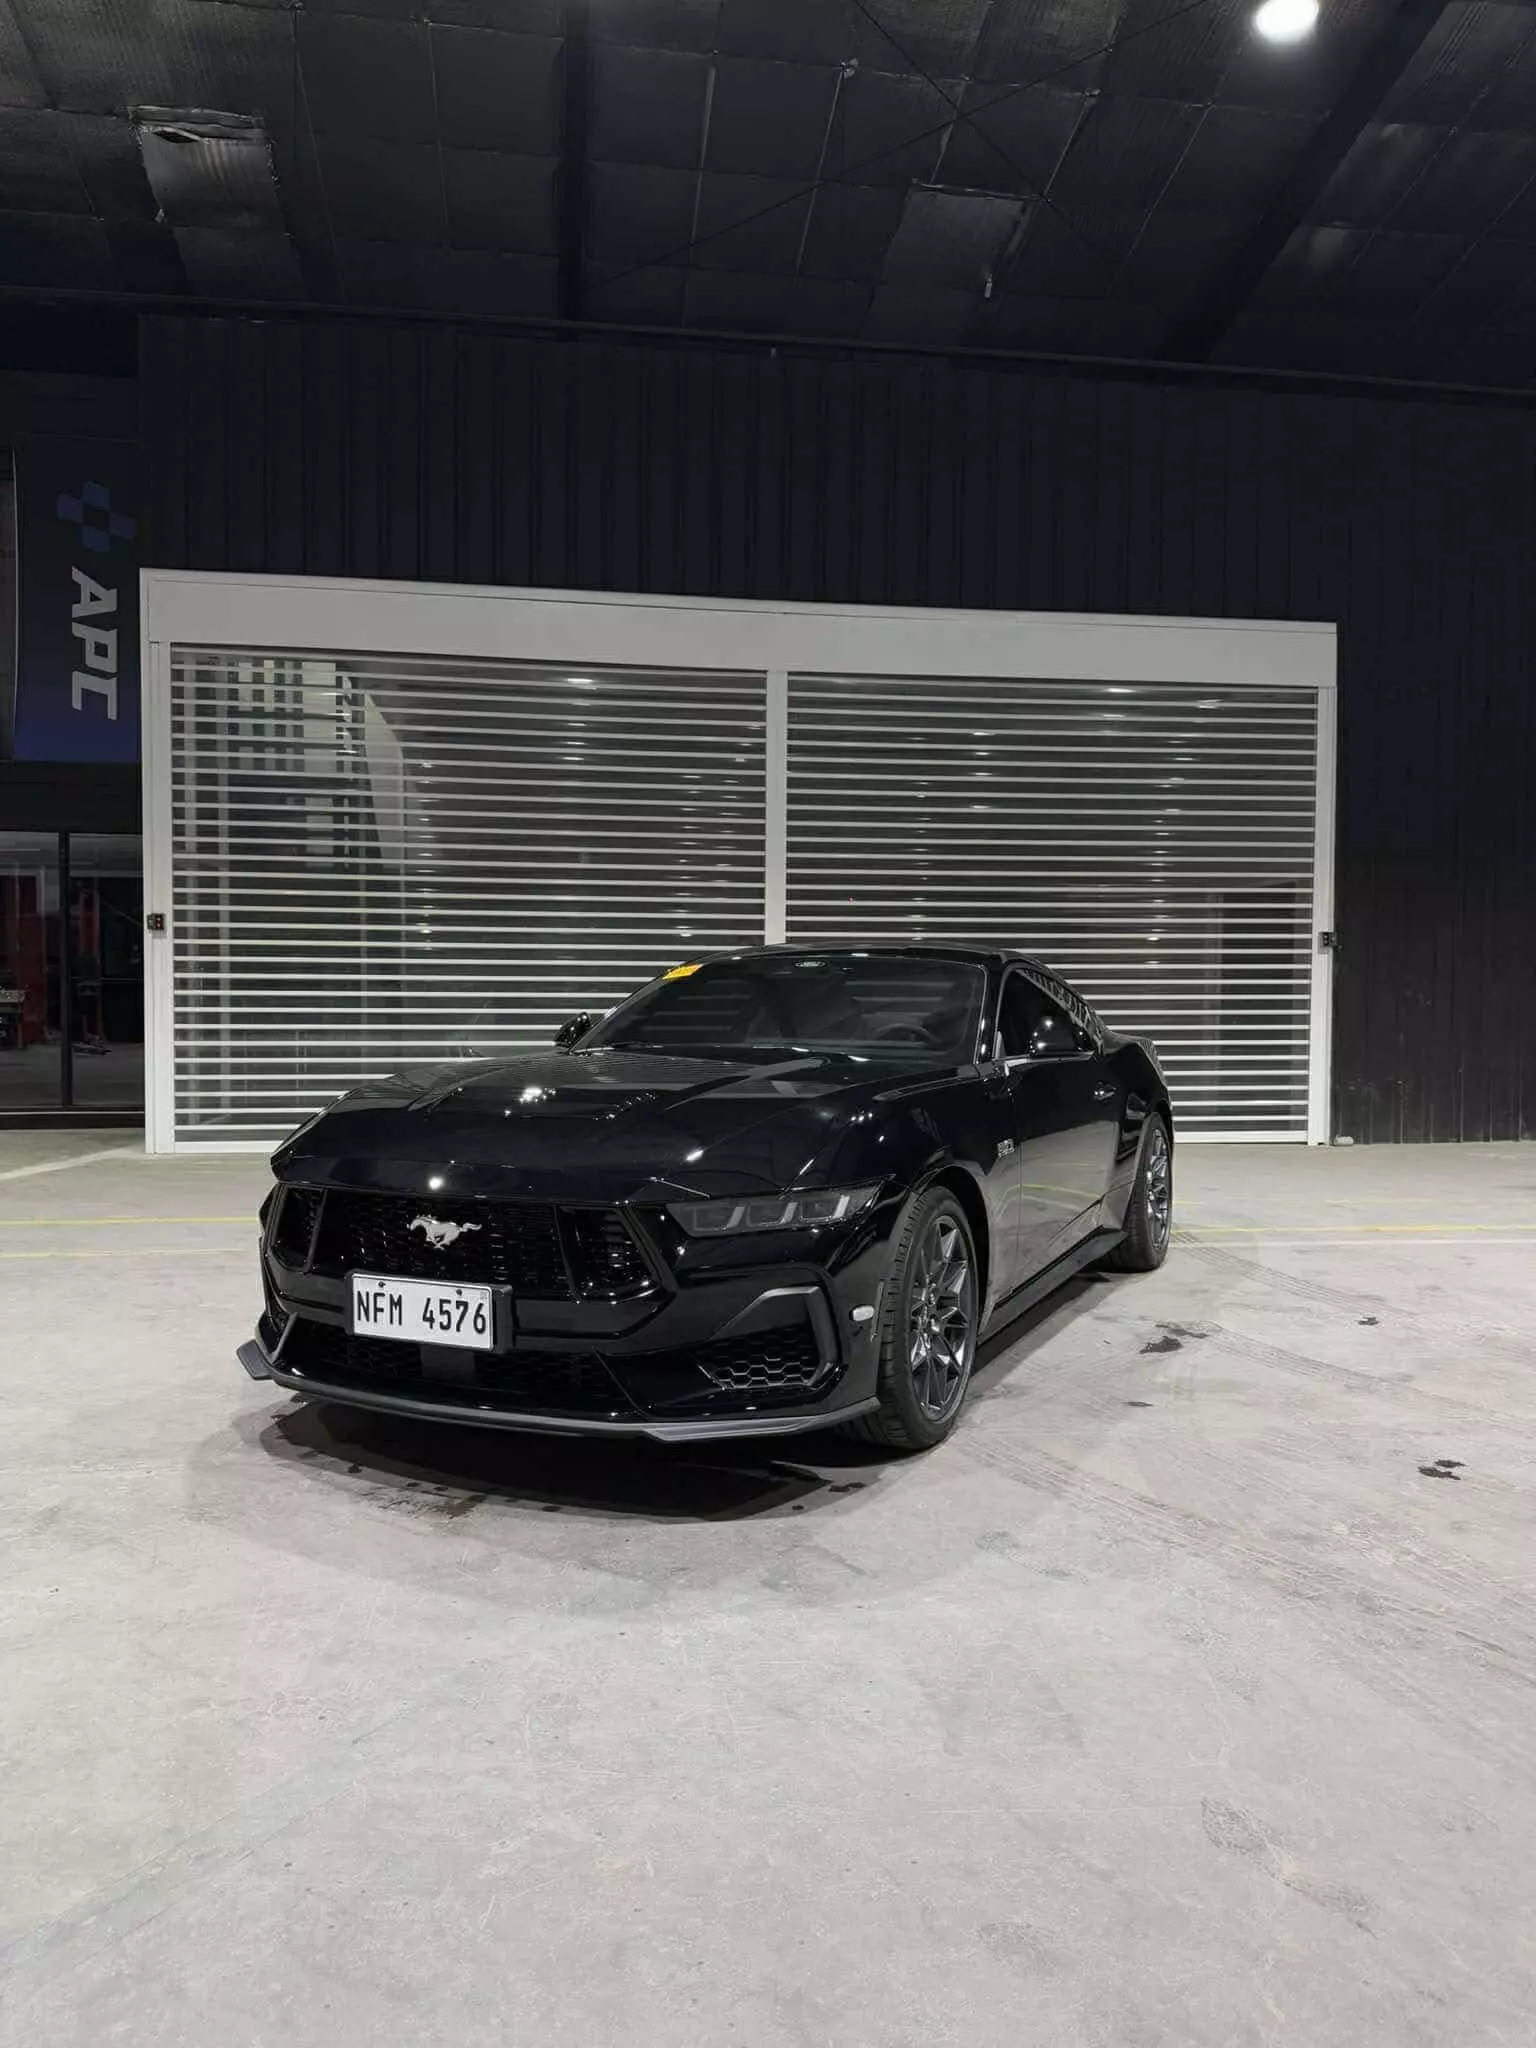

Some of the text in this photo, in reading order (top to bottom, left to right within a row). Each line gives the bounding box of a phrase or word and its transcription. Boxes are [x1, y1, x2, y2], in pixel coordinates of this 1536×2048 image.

[71, 566, 118, 720] APC
[357, 1290, 487, 1334] NFM 4576
